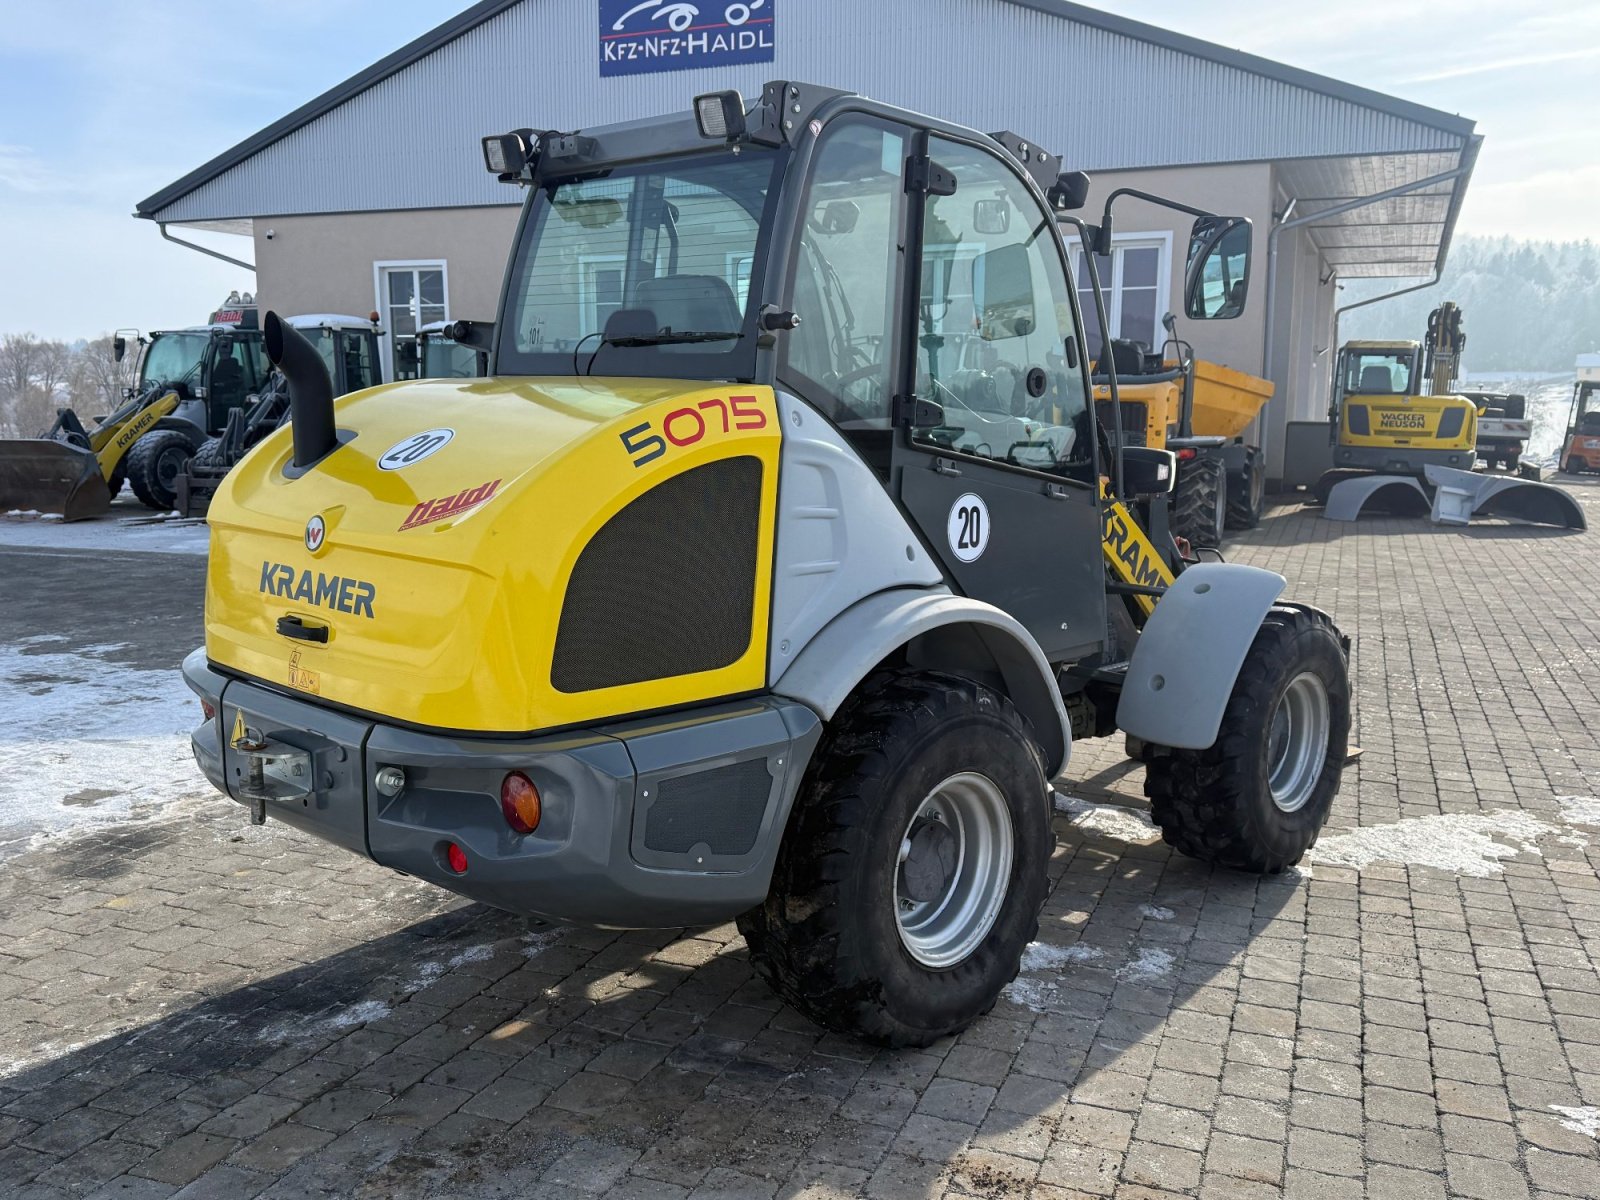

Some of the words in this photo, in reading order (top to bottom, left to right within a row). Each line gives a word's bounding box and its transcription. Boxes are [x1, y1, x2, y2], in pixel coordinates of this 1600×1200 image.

[116, 412, 153, 448] KRAMER
[619, 395, 767, 468] 5075
[1380, 412, 1425, 421] WACKER
[1380, 420, 1425, 429] NEUSON
[384, 434, 446, 463] 20
[403, 478, 503, 526] Haidl
[957, 505, 981, 549] 20
[259, 560, 376, 619] KRAMER
